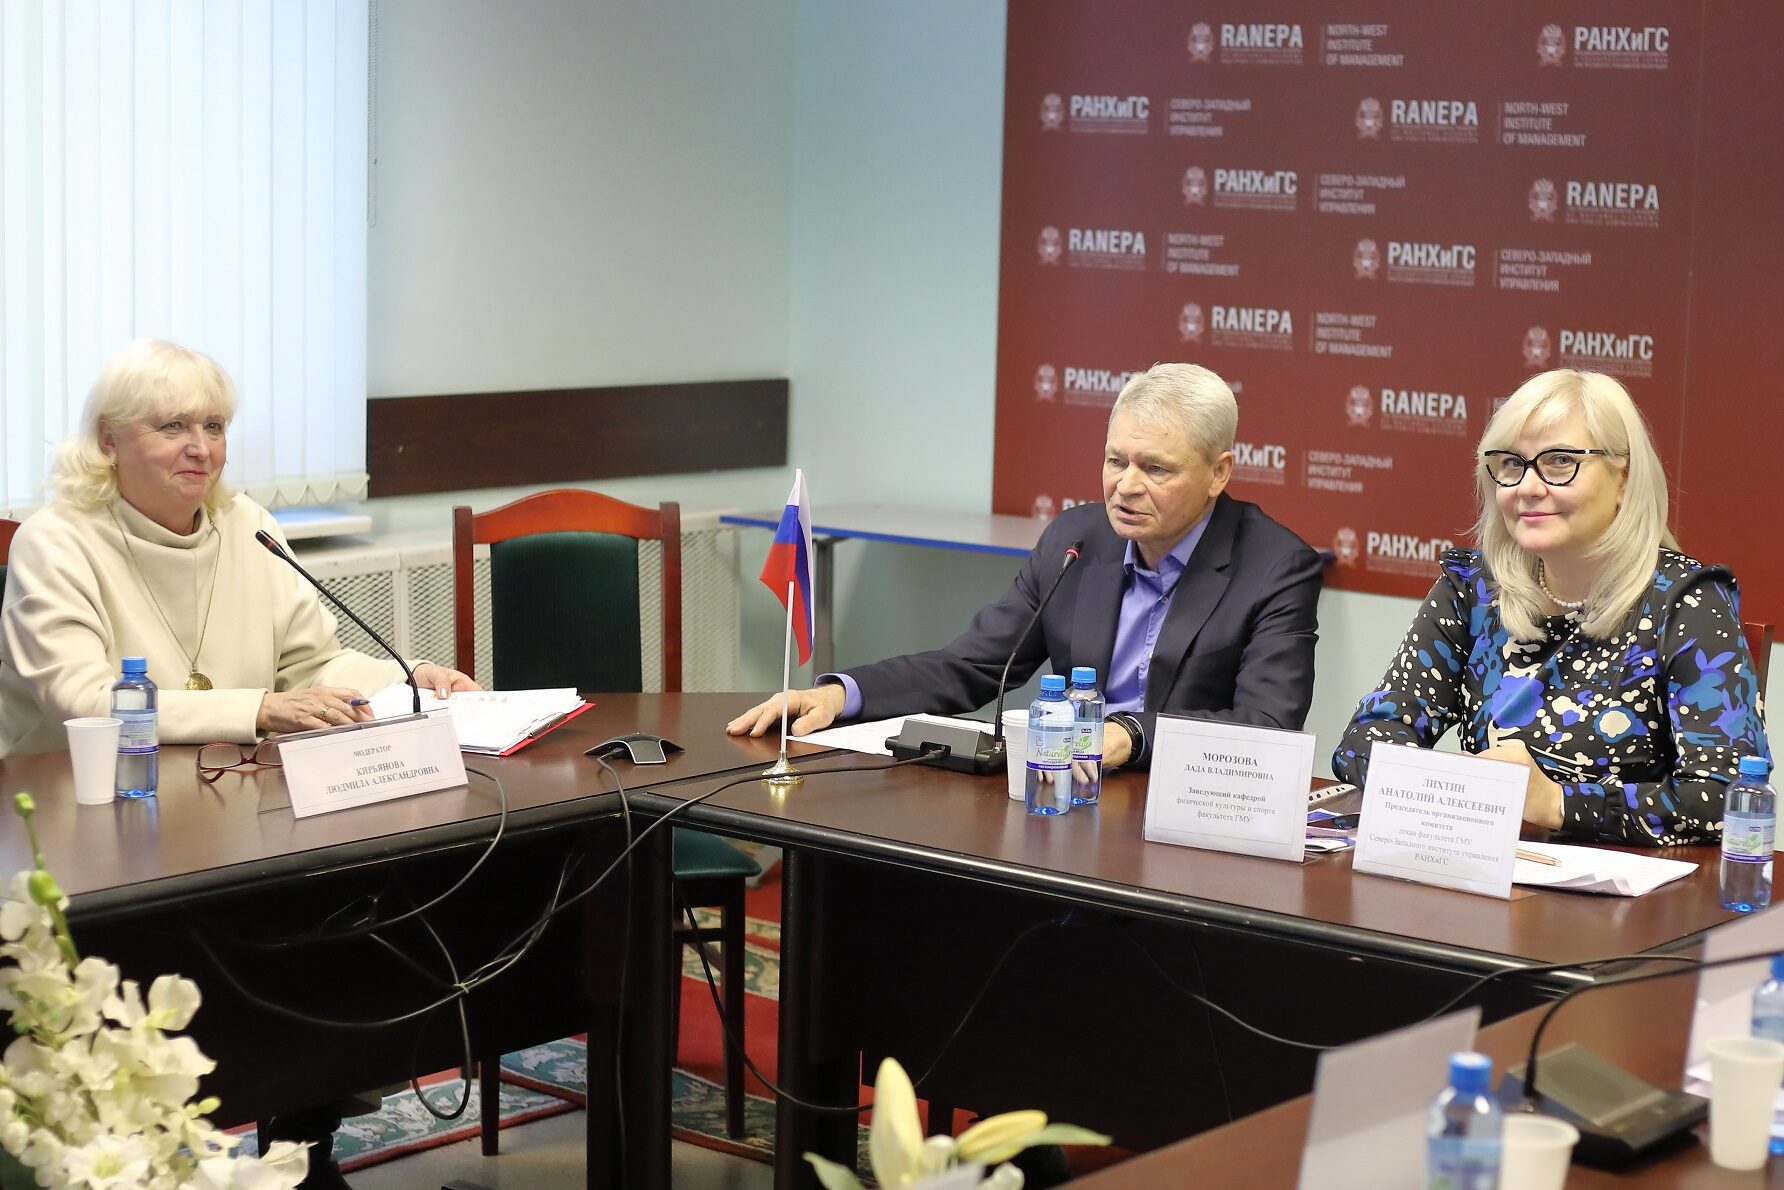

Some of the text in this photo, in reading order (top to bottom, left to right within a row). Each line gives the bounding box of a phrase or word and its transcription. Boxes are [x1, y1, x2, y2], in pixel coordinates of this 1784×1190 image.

[1221, 24, 1302, 47] RANEPA
[1575, 27, 1669, 51] РАНХиГС
[1071, 96, 1149, 119] РАНХиГС
[1392, 100, 1478, 125] RANEPA
[1503, 133, 1515, 144] OF
[1215, 169, 1297, 194] РАНХиГС
[1567, 182, 1659, 209] RANEPA
[1069, 229, 1145, 254] RANEPA
[1388, 242, 1475, 269] РАНХиГС
[1212, 307, 1292, 333] RANEPA
[1560, 331, 1653, 360] РАНХиГС
[1064, 368, 1137, 392] РАНХиГ
[1382, 390, 1466, 418] RANEPA
[1231, 443, 1285, 469] НХиГС
[354, 745, 391, 757] МОДЕРАТОР
[1202, 753, 1258, 766] МОРОЗОВА
[326, 766, 439, 794] ЛЮДМИЛА АЛЕКСАНДРОВНА
[357, 761, 405, 776] КИРЬЯНОВА
[1184, 764, 1274, 781] ЛАДА ВЛАДИМИРОВНА
[1189, 787, 1265, 802] Заведующий кафедрой
[1422, 779, 1465, 793] ЛИХТИН
[1379, 787, 1506, 815] АНАТОЛИЙ АЛЕКСЕЕВИЧ
